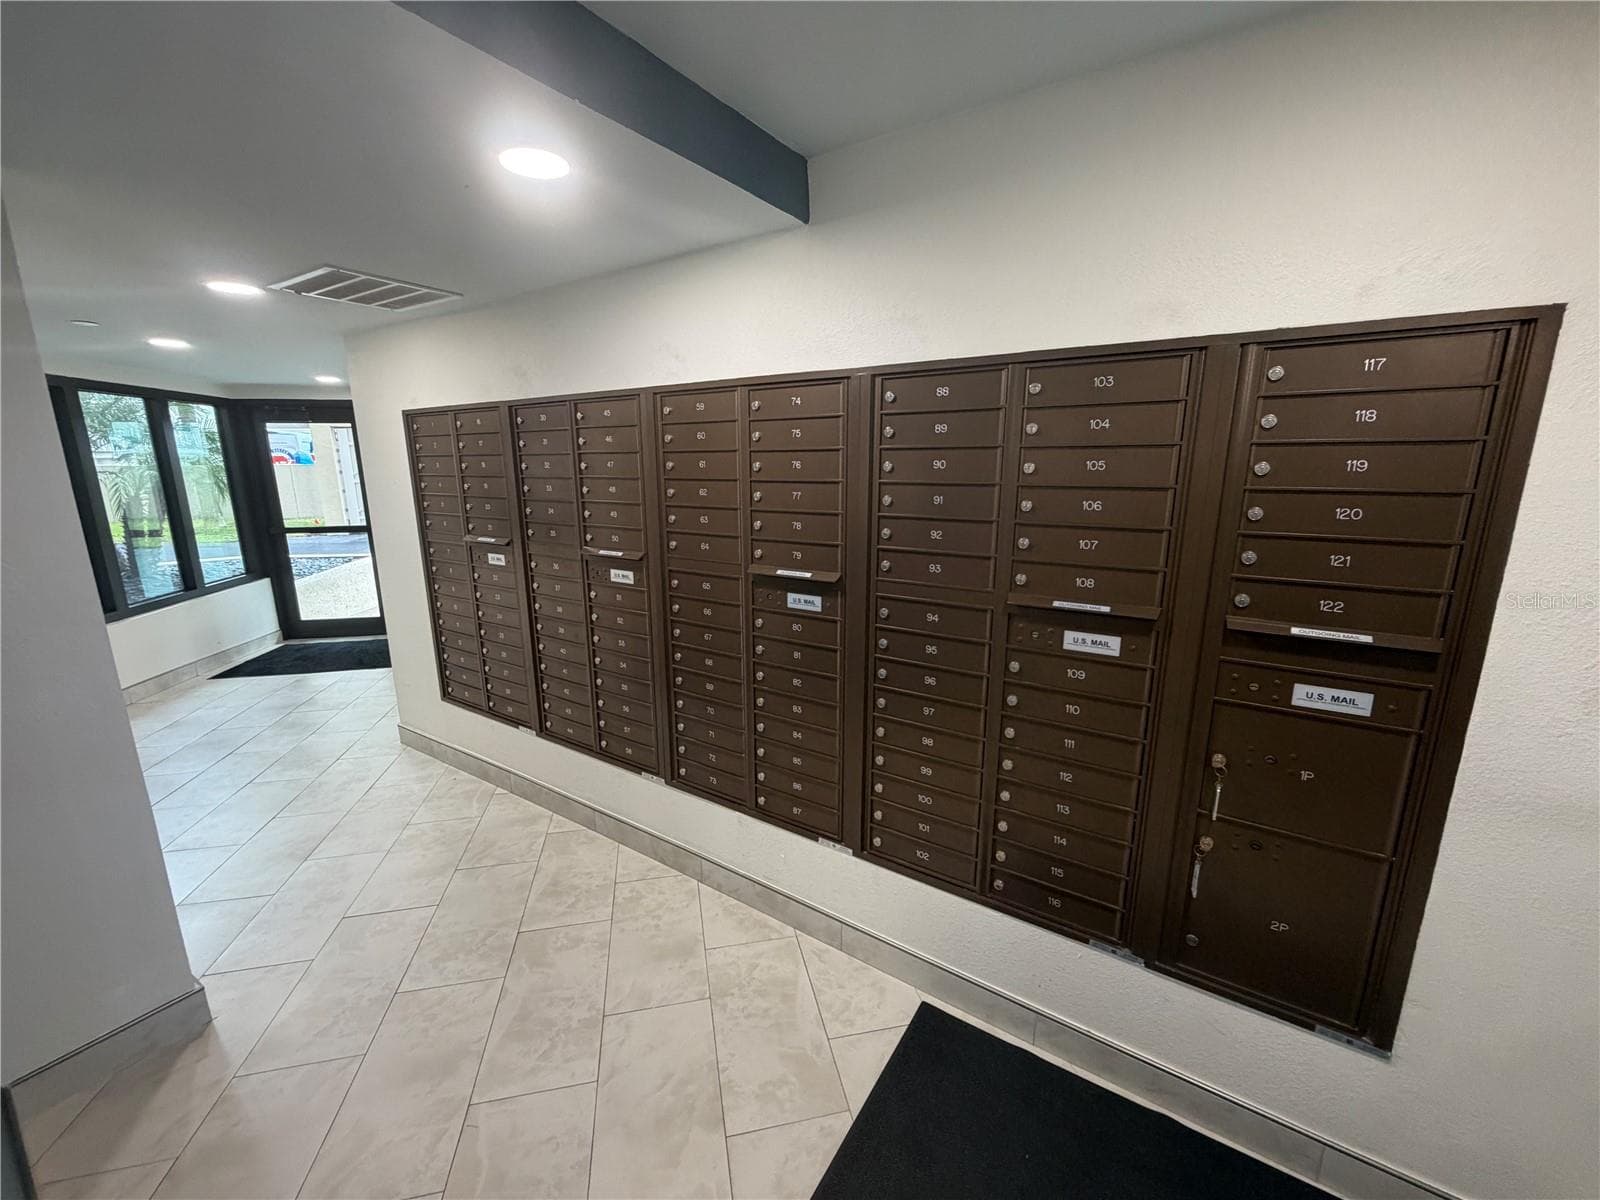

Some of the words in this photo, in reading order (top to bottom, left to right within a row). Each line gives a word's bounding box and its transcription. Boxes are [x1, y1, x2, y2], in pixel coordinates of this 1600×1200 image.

[1364, 357, 1387, 371] 117
[1094, 375, 1114, 387] 103
[936, 386, 949, 397] 88
[791, 397, 801, 405] 74
[696, 402, 705, 411] 59
[1355, 409, 1377, 422] 118
[934, 423, 948, 433] 89
[1090, 418, 1110, 430] 104
[696, 431, 706, 440] 60
[791, 429, 801, 438] 75
[699, 460, 706, 468] 61
[791, 460, 802, 469] 76
[933, 459, 946, 469] 90
[1086, 460, 1106, 471] 105
[1346, 459, 1368, 472] 119
[699, 488, 708, 496] 62
[792, 491, 802, 500] 77
[933, 495, 943, 505] 91
[1082, 500, 1102, 511] 106
[1335, 508, 1363, 520] 120
[700, 515, 709, 524] 63
[791, 521, 802, 530] 78
[930, 530, 943, 540] 92
[700, 542, 710, 550] 64
[1079, 539, 1099, 550] 107
[792, 551, 802, 560] 79
[1330, 555, 1351, 567] 121
[929, 563, 942, 573] 93
[702, 582, 711, 590] 65
[1076, 577, 1095, 588] 108
[1319, 600, 1344, 613] 122
[703, 608, 712, 616] 66
[926, 613, 939, 622] 94
[792, 623, 802, 632] 80
[704, 633, 713, 641] 67
[1072, 636, 1089, 645] U.S.
[1091, 639, 1111, 648] MAIL
[925, 645, 938, 655] 95
[793, 651, 801, 660] 81
[1067, 668, 1086, 680] 109
[792, 678, 802, 687] 82
[924, 676, 937, 686] 96
[1305, 691, 1327, 701] U.S.
[1330, 695, 1359, 706] MAIL
[706, 706, 715, 715] 70
[792, 705, 802, 714] 83
[923, 706, 935, 716] 97
[1065, 704, 1080, 715] 110
[708, 730, 715, 738] 71
[792, 731, 802, 739] 84
[921, 736, 934, 746] 98
[1064, 738, 1075, 749] 111
[708, 753, 716, 762] 72
[792, 757, 802, 766] 85
[920, 766, 932, 776] 99
[1300, 770, 1315, 781] 1P
[709, 776, 717, 785] 73
[1059, 771, 1073, 783] 112
[918, 794, 933, 805] 100
[792, 807, 802, 815] 87
[1056, 803, 1070, 815] 113
[918, 823, 930, 833] 101
[1053, 835, 1067, 846] 114
[916, 849, 930, 861] 102
[1051, 866, 1064, 878] 115
[1048, 896, 1062, 908] 116
[1270, 920, 1289, 932] 2P
